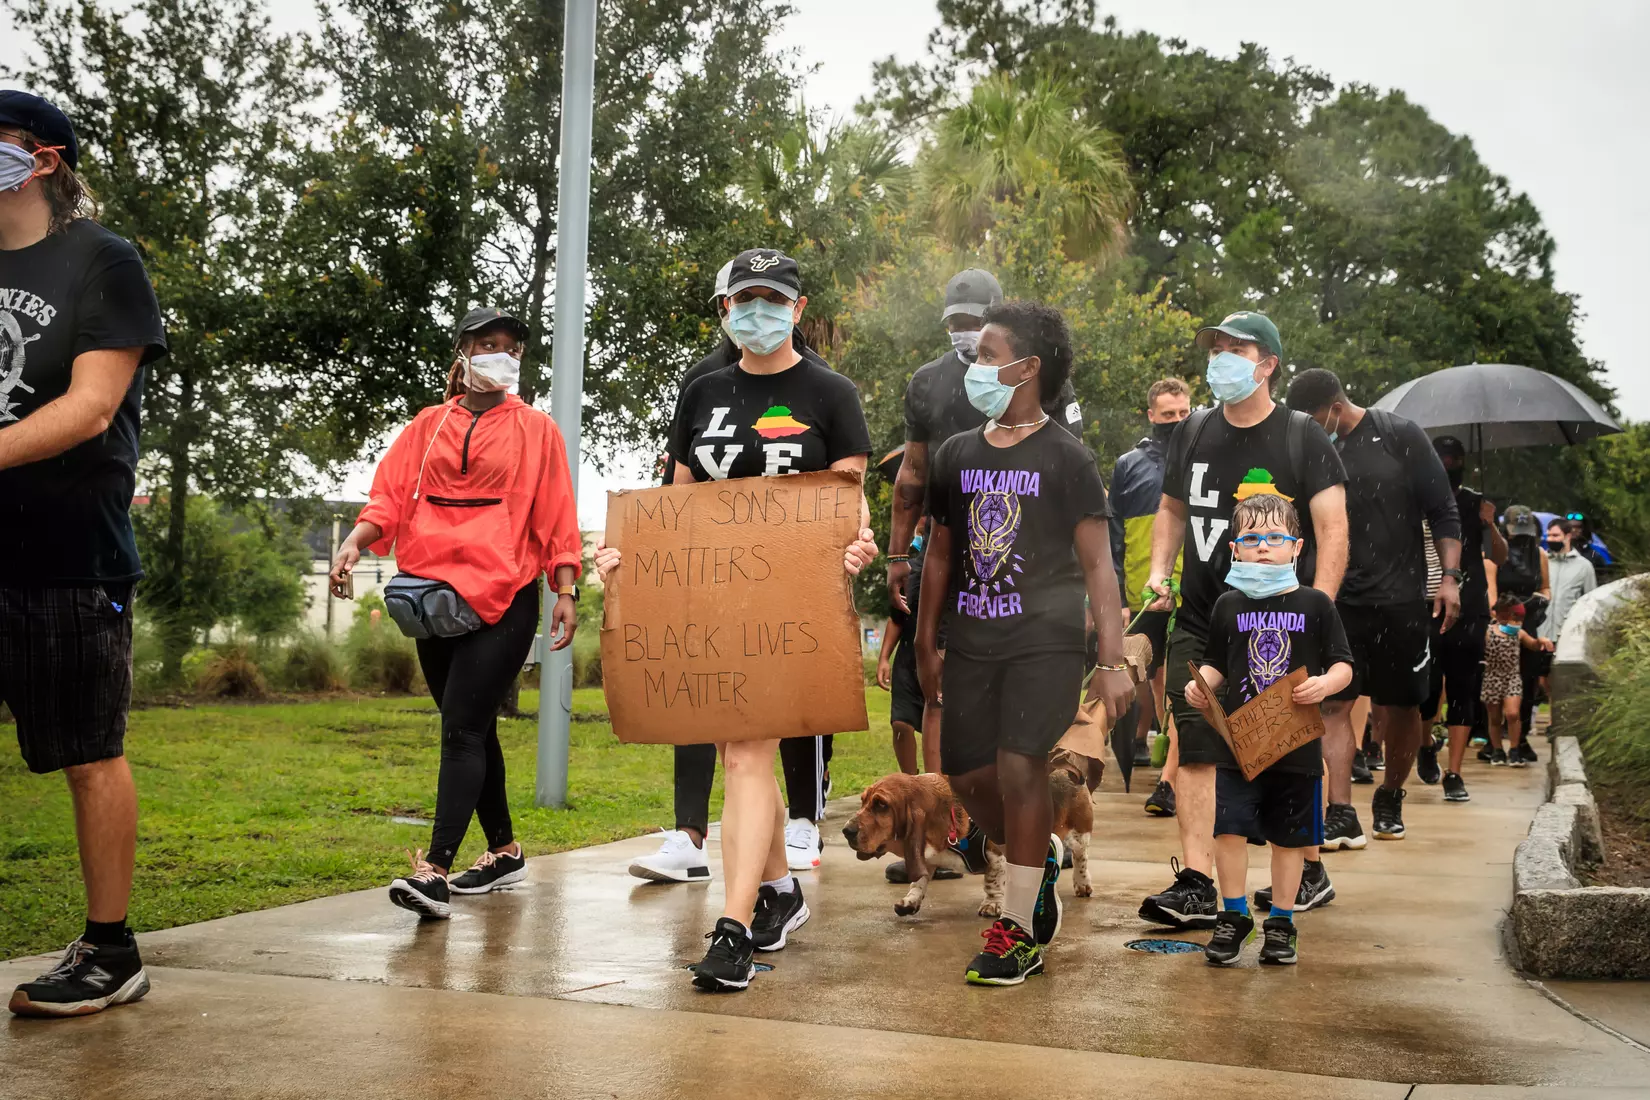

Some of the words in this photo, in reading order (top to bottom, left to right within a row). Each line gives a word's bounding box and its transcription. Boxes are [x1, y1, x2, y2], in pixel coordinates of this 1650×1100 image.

[960, 469, 1040, 497] WAKANDA
[636, 493, 693, 533] MY
[796, 486, 853, 523] LIFE
[634, 544, 771, 588] MATTERS
[624, 623, 720, 661] BLACK
[743, 622, 818, 657] LIVES
[1236, 612, 1305, 633] WAKANDA
[644, 668, 748, 708] MATTER
[1277, 722, 1323, 752] MATTER
